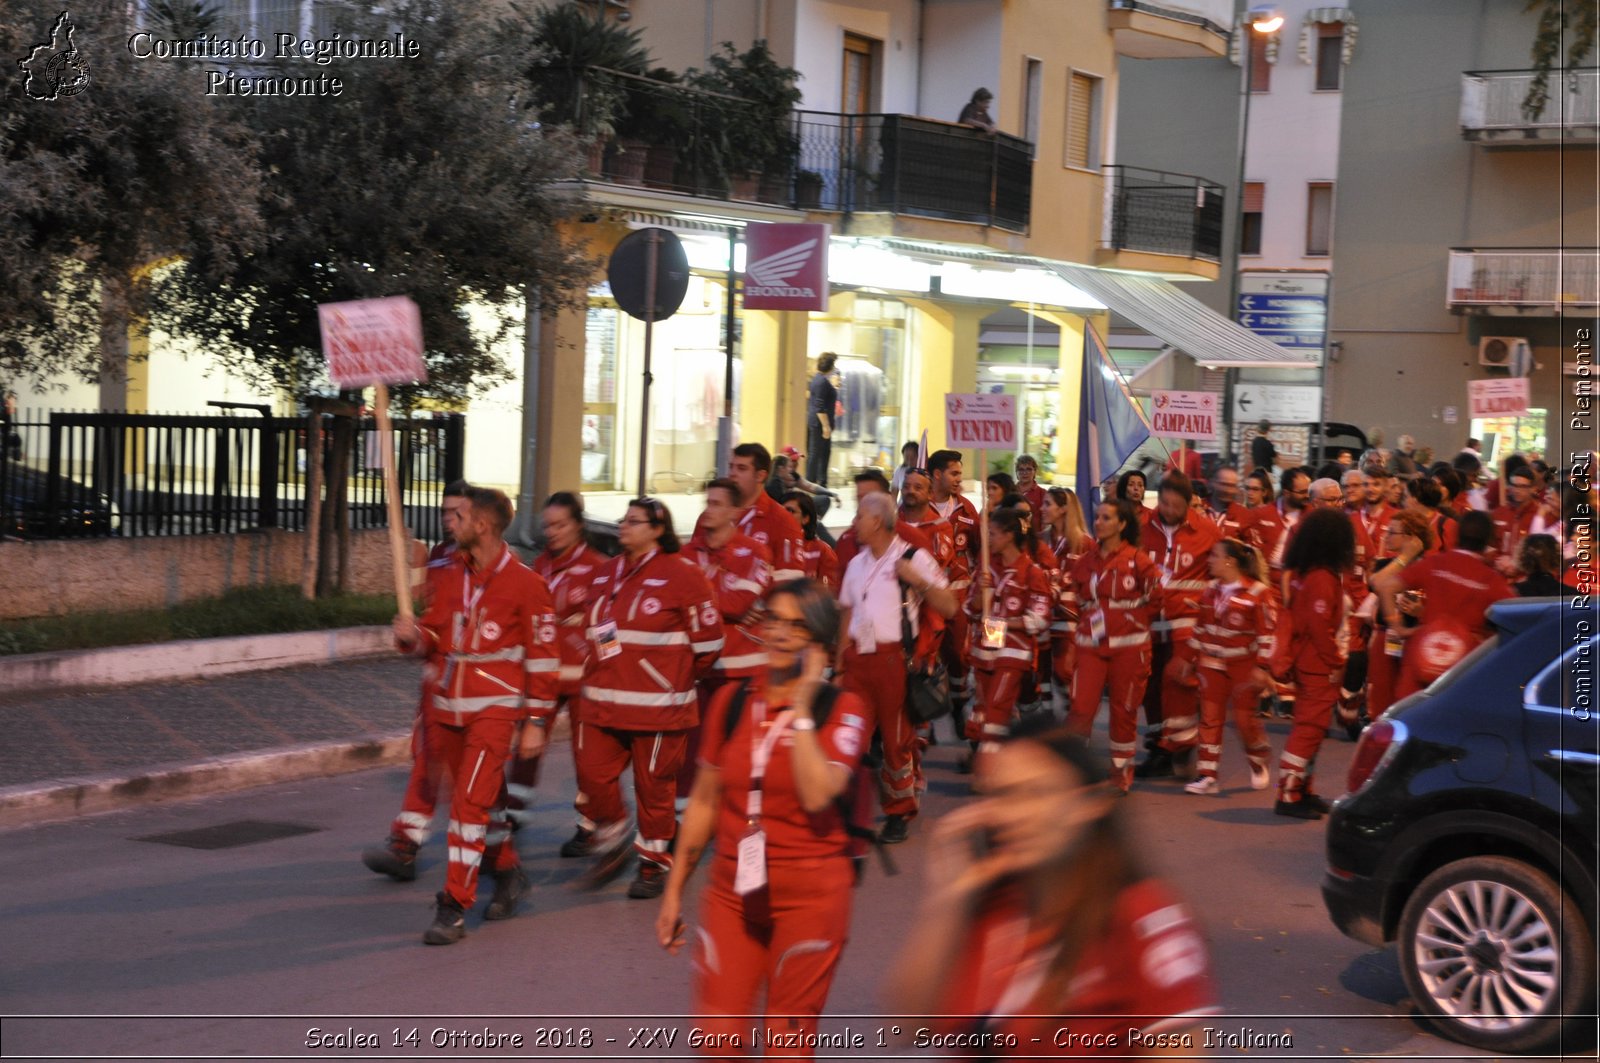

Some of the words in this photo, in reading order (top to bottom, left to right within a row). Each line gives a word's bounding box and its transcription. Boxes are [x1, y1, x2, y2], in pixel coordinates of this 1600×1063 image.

[746, 286, 818, 298] HONDA
[949, 419, 1013, 442] VENETO
[1153, 413, 1213, 434] CAMPANIA
